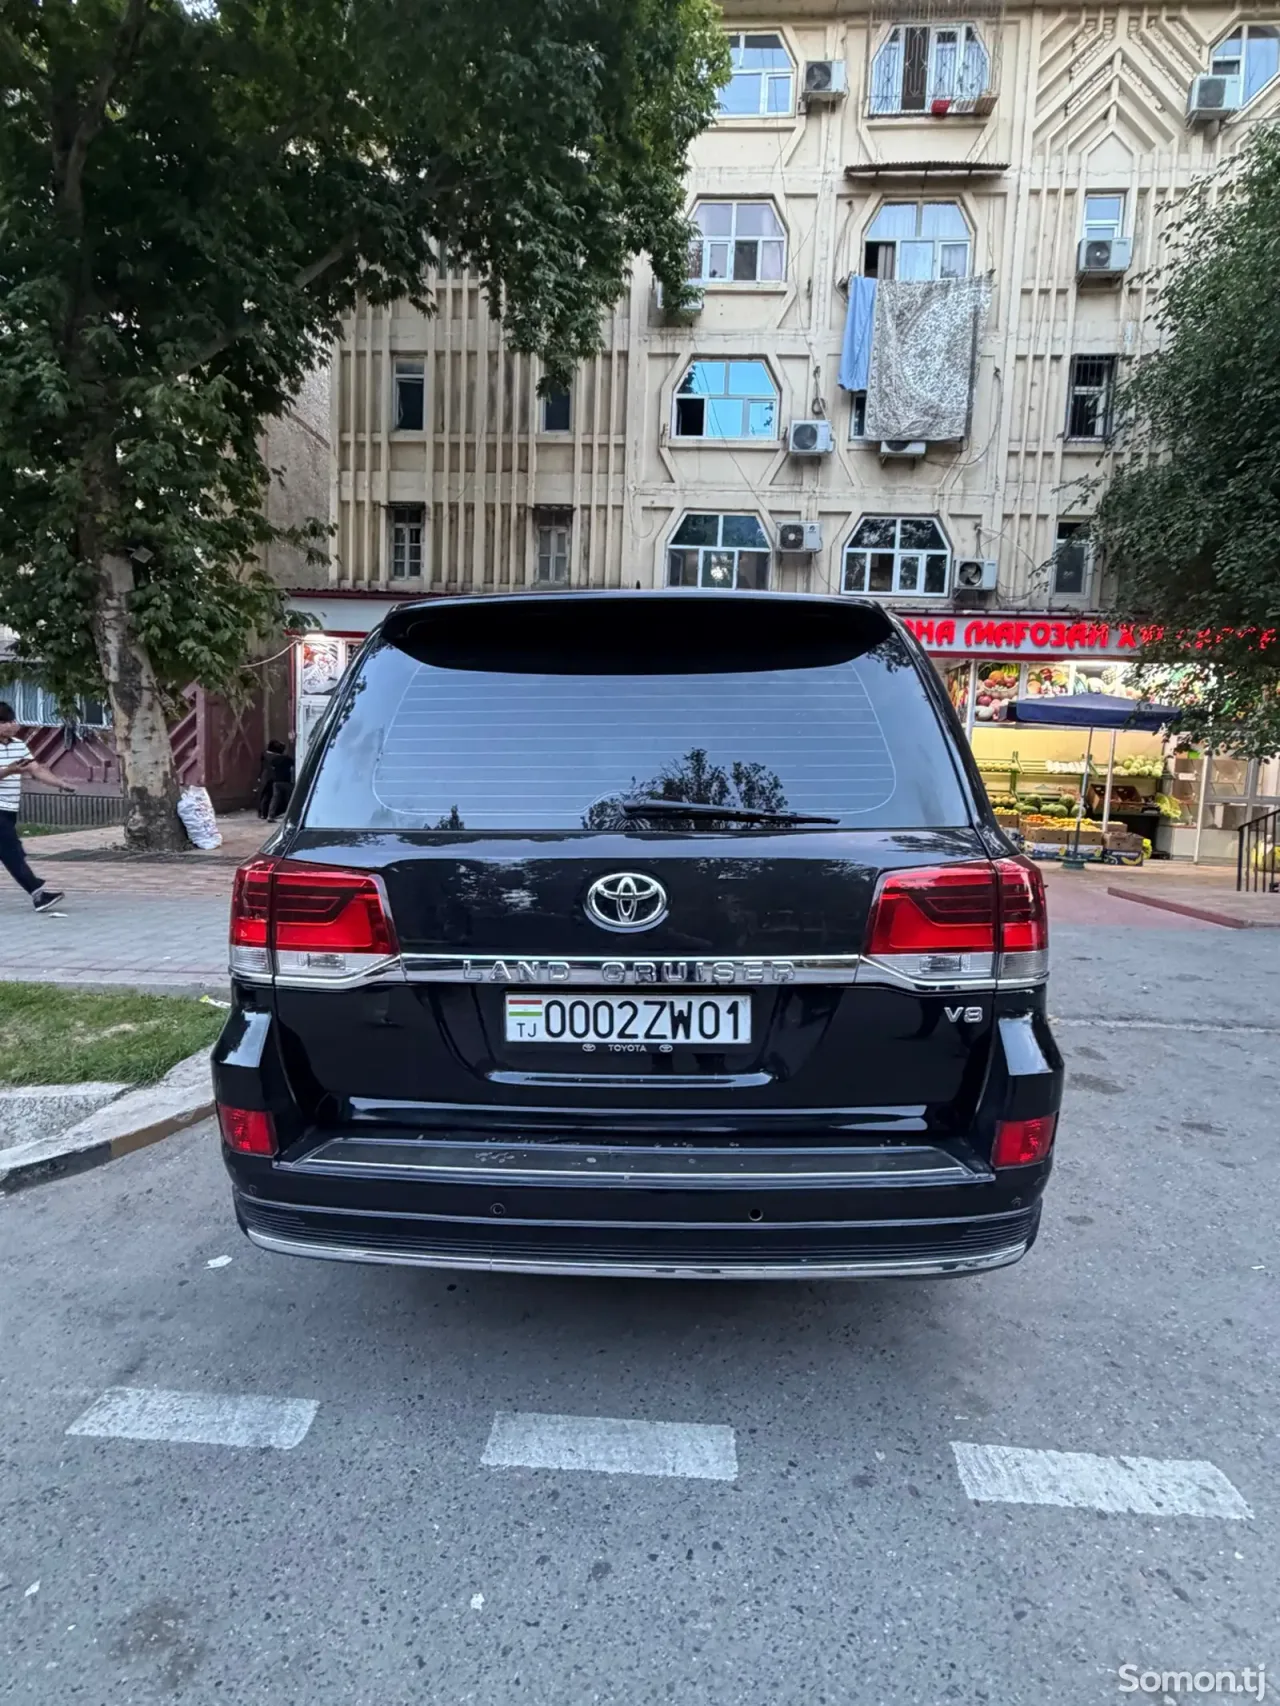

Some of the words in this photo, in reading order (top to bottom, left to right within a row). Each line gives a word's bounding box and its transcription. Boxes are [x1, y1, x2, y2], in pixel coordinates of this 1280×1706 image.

[463, 959, 571, 983] LAND
[601, 961, 796, 984] CRUISER
[516, 1022, 537, 1038] TJ
[544, 999, 740, 1040] 0002ZW01
[944, 1006, 983, 1023] V8
[608, 1044, 647, 1052] TOYOTA
